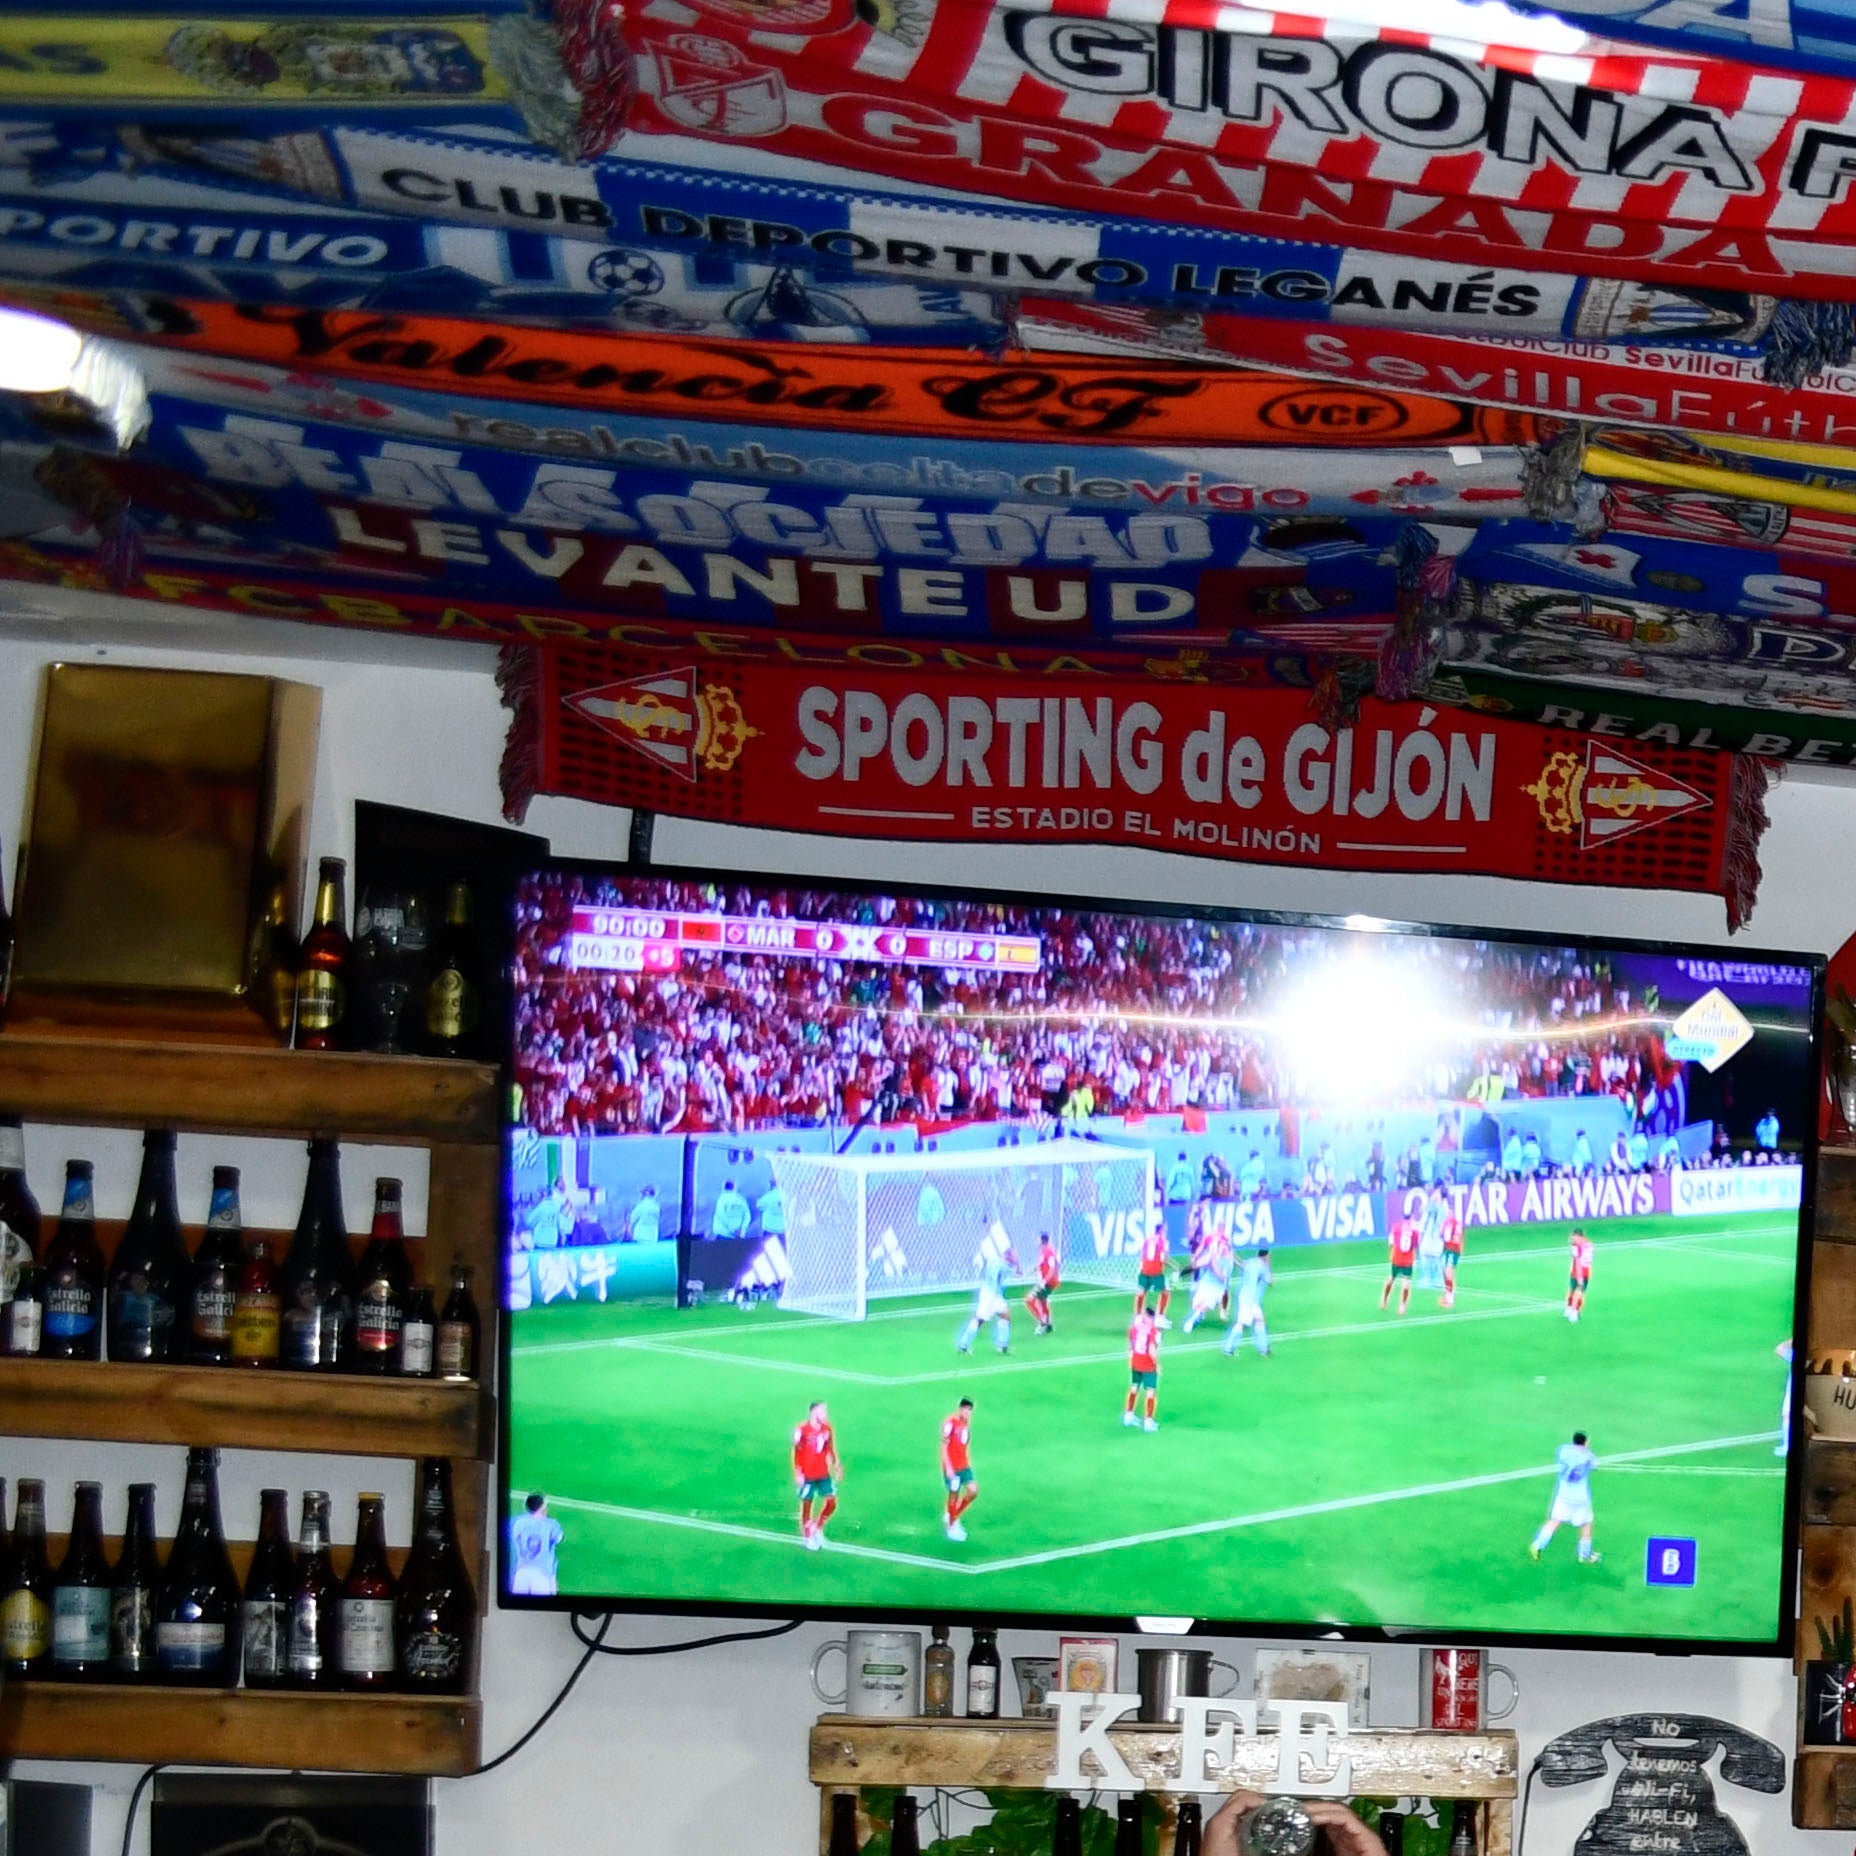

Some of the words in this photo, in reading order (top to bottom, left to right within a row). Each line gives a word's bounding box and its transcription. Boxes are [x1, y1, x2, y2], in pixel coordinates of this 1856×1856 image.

[1001, 7, 1760, 195] GIRONA
[823, 95, 1795, 282] GRANADA
[383, 168, 616, 228] CLUB
[642, 203, 1146, 287] DEPORTIVO
[1172, 264, 1541, 319] LEGANÉS
[238, 301, 895, 413] Valencia
[1285, 401, 1387, 427] VCF
[329, 504, 988, 621] LEVANTE
[1008, 576, 1199, 623] UD
[318, 592, 1112, 677] BARCELONA
[1537, 702, 1721, 755] REAL
[795, 684, 1165, 796] SPORTING
[1181, 709, 1268, 808] de
[1282, 705, 1497, 825] GIJÓN
[970, 804, 1116, 832] ESTADIO
[1125, 809, 1165, 835] EL
[1173, 814, 1323, 855] MOLINÓN
[592, 913, 667, 941] 90:00
[746, 925, 796, 950] MAR
[815, 930, 834, 952] 0
[928, 938, 975, 961] ESP
[1202, 1199, 1275, 1247] VISA
[1302, 1192, 1376, 1239] VISA
[1403, 1183, 1509, 1228] QTAR
[1520, 1174, 1655, 1224] AIRWAYS
[1086, 1210, 1152, 1258] VIS
[1650, 1718, 1681, 1737] No
[1627, 1749, 1699, 1772] tenemos
[1626, 1808, 1699, 1827] HABLEN
[1628, 1834, 1682, 1853] entre
